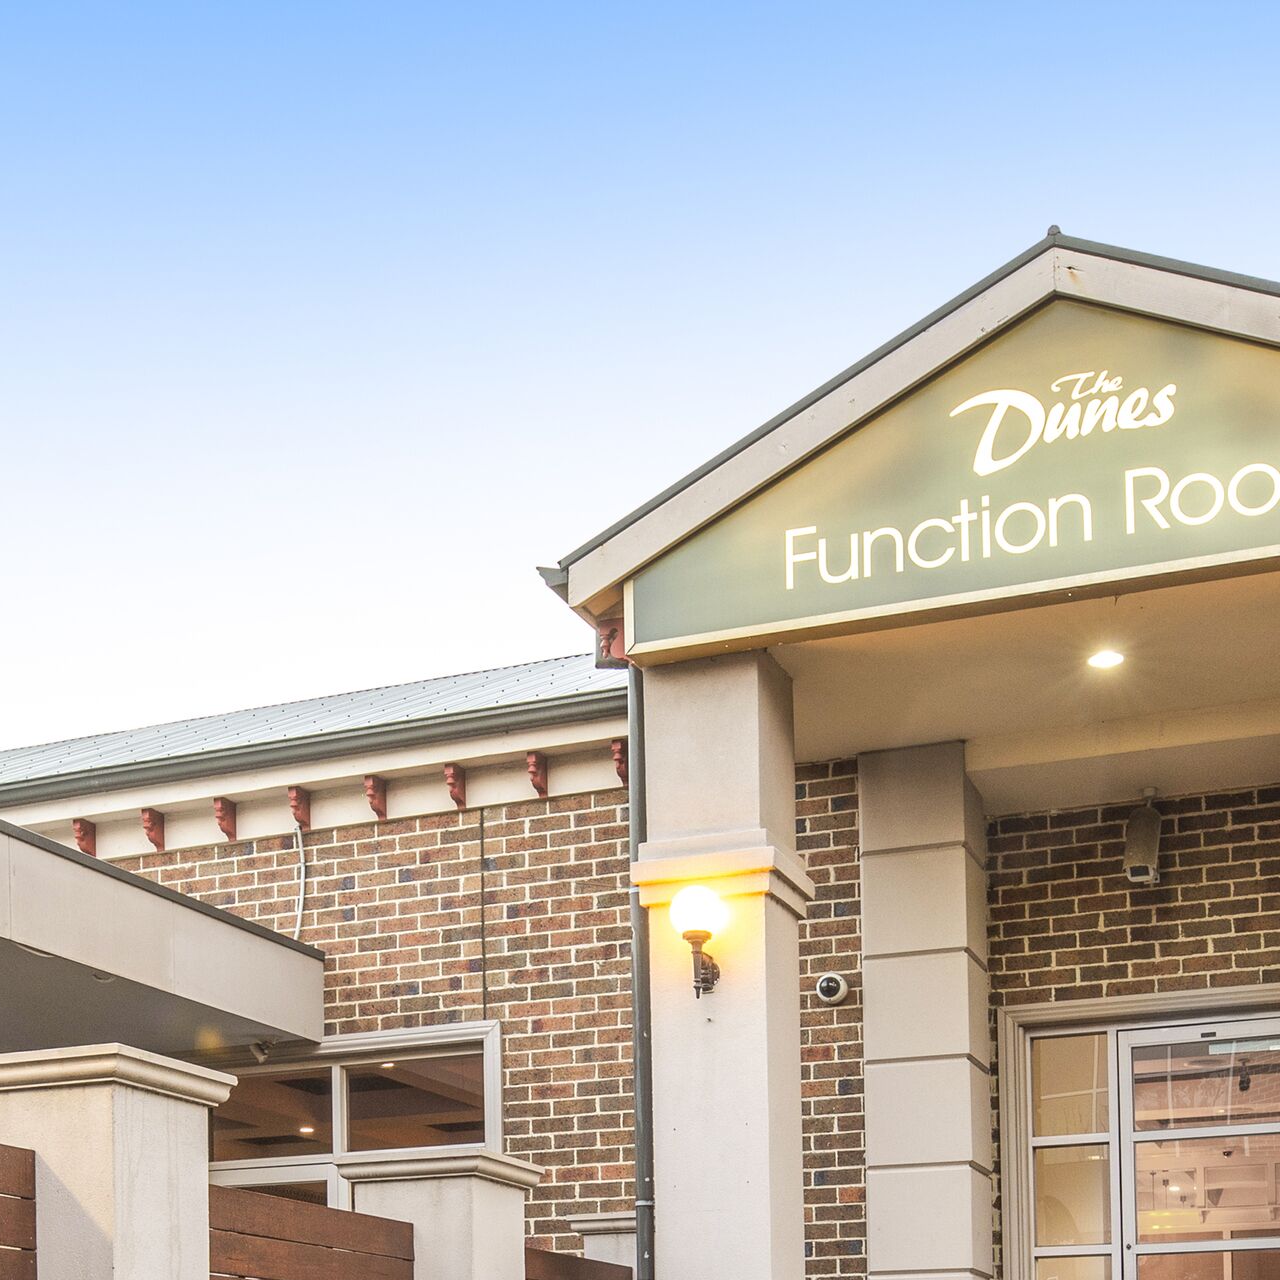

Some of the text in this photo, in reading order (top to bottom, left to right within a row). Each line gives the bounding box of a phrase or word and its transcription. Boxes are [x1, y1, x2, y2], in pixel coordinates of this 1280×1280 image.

[949, 382, 1177, 477] Dunes
[1051, 370, 1123, 398] The
[783, 492, 1094, 590] Function
